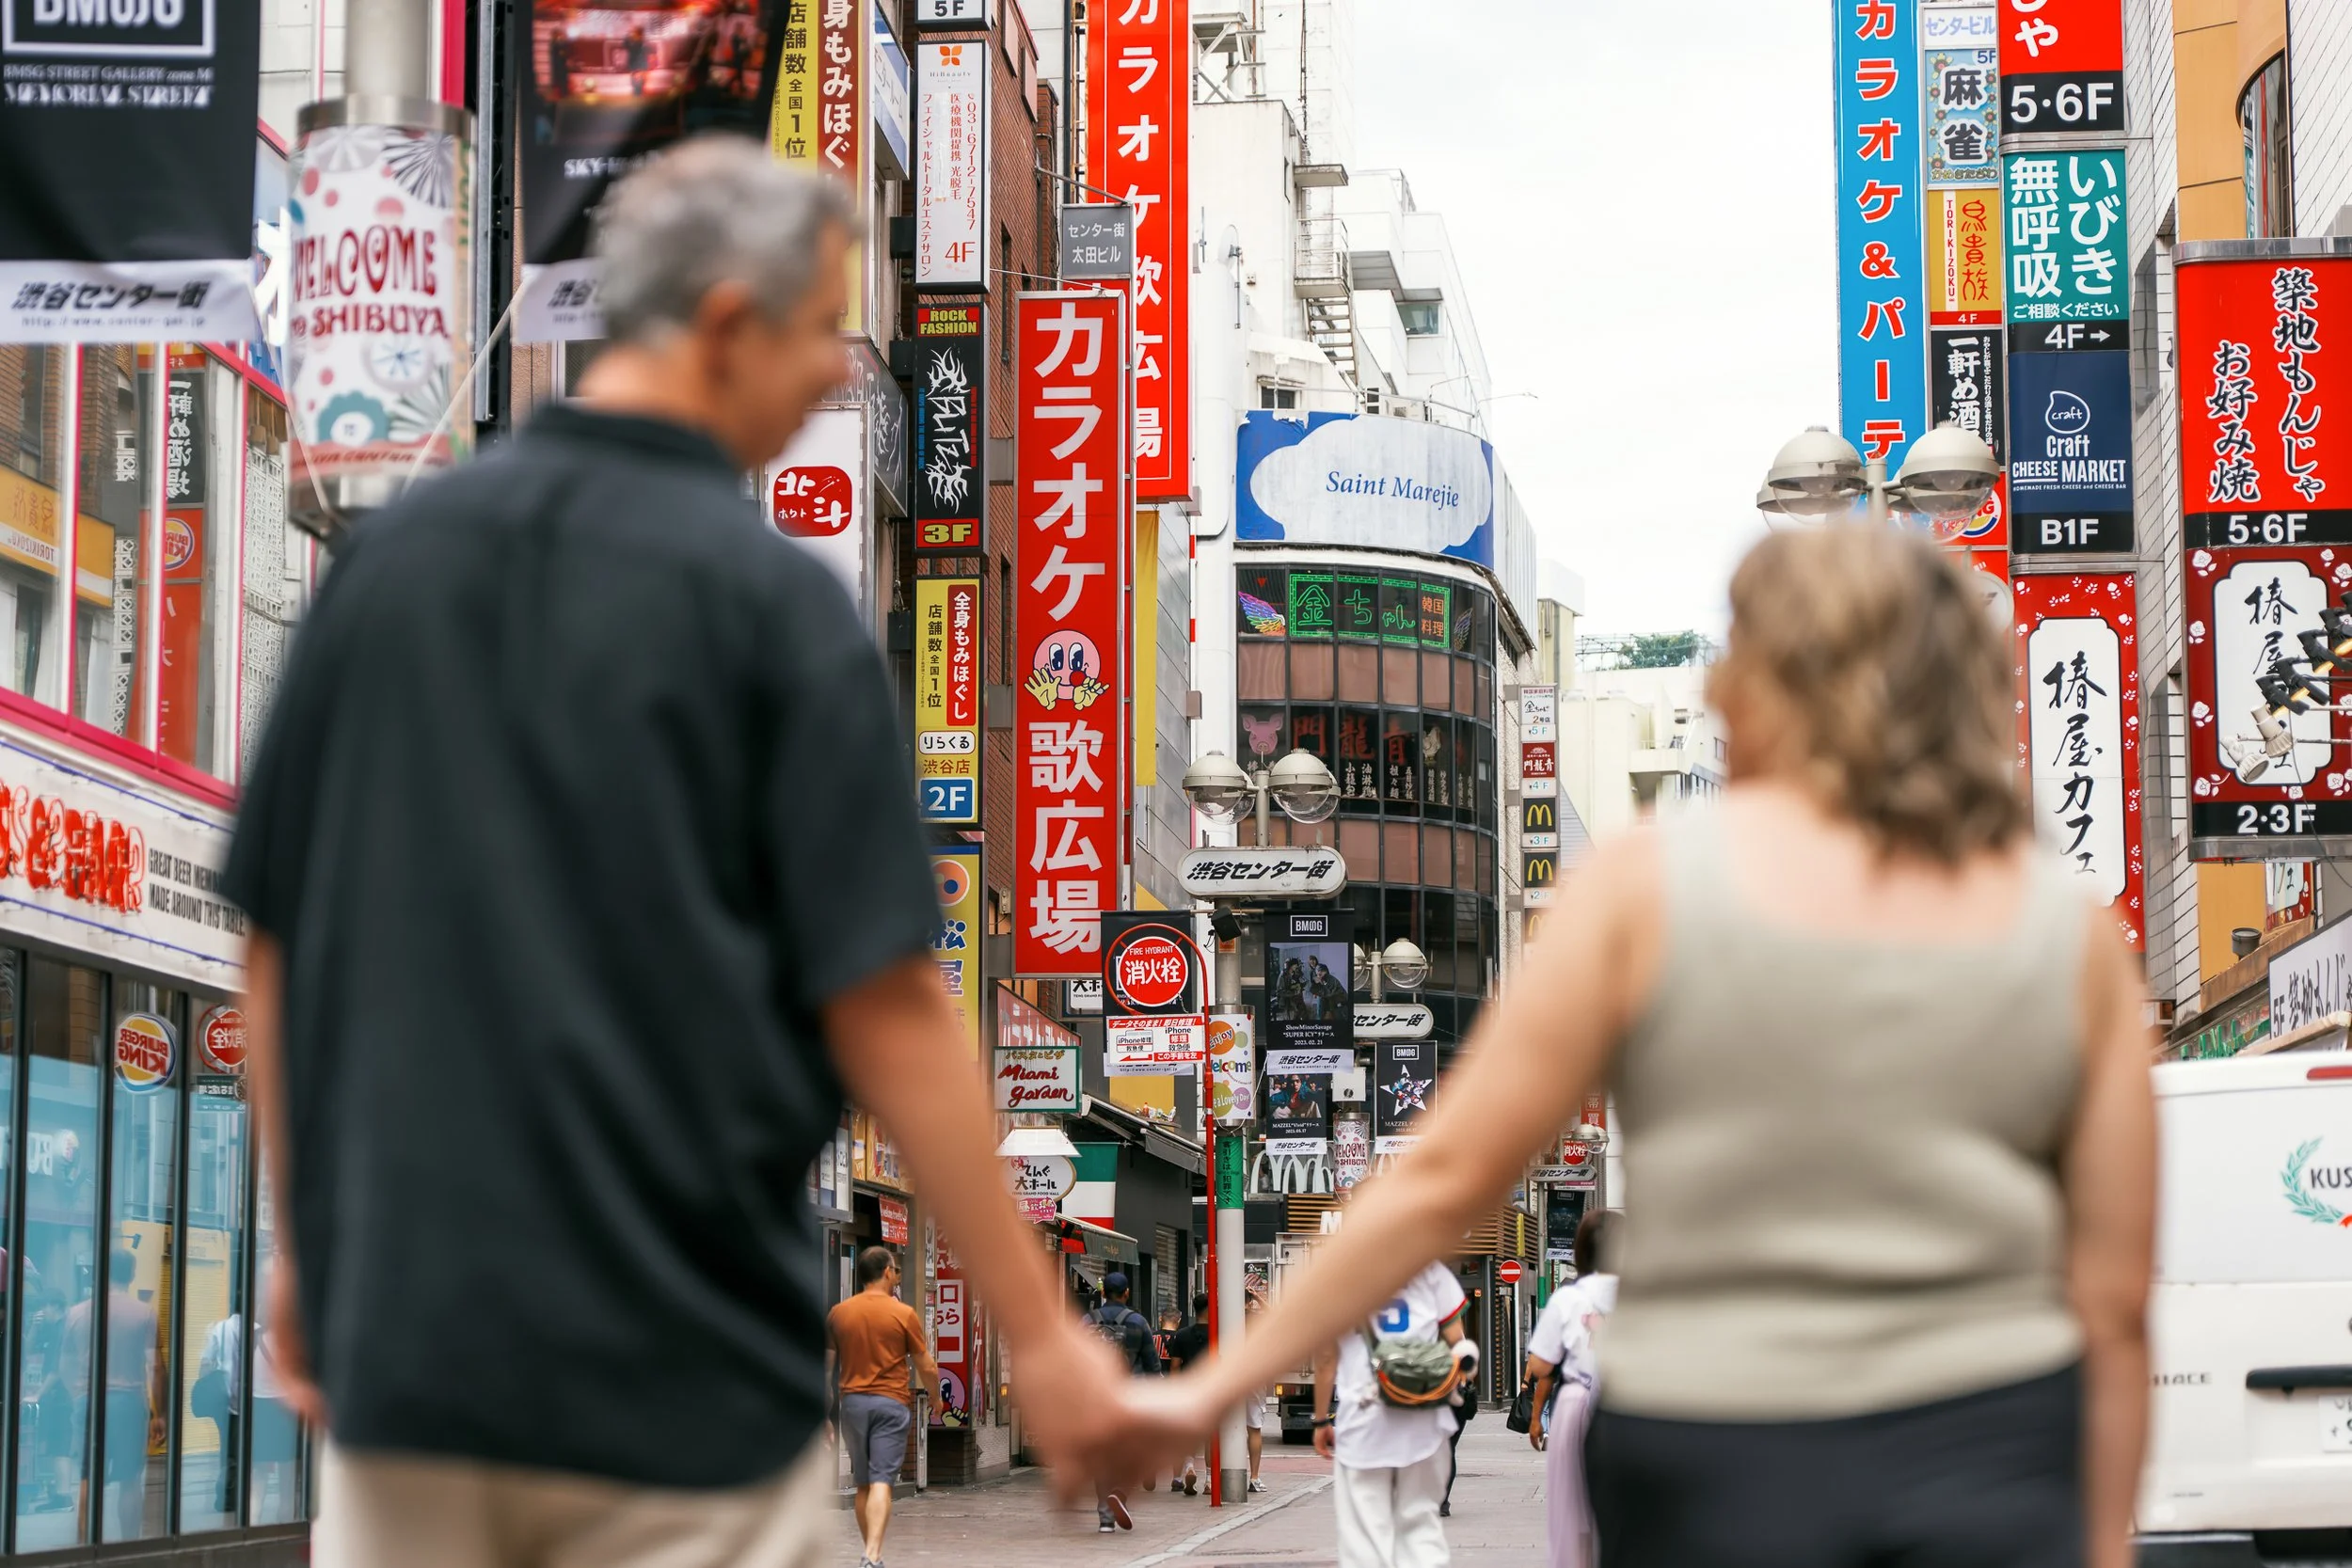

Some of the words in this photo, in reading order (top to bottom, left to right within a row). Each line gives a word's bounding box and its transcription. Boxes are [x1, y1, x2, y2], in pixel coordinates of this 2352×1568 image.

[934, 1, 964, 17] 5F
[1925, 16, 1995, 36] センタービル
[822, 0, 853, 179] 身もみほぐ
[1944, 69, 1983, 161] 麻雀
[1068, 222, 1125, 238] センター街
[2010, 157, 2062, 298] 無呼吸
[2069, 156, 2121, 295] いびき
[945, 242, 976, 263] 4F
[1073, 245, 1121, 263] 太田ビル
[1947, 200, 1955, 296] TORIKIZOKU
[1962, 199, 1989, 301] 鳥貴族
[291, 226, 437, 302] WELCOME
[11, 281, 211, 309] 渋谷センター街
[930, 309, 967, 322] ROCK
[1958, 314, 1978, 324] 4F
[2013, 303, 2120, 319] ご相談ください
[312, 305, 451, 340] SHIBUYA
[920, 322, 977, 335] FASHION
[2045, 324, 2086, 349] 4F
[2273, 269, 2324, 499] 築地もんじゃ
[2052, 407, 2083, 420] craft
[2208, 341, 2258, 501] お好み焼
[2046, 435, 2090, 458] Craft
[1031, 302, 1105, 622] カラオケ
[2012, 461, 2058, 478] CHEESE
[2061, 459, 2126, 483] MARKET
[1327, 471, 1386, 496] Saint
[1391, 477, 1458, 510] Marejie
[778, 507, 807, 519] ホクト
[924, 524, 971, 543] 3F
[2042, 518, 2099, 546] B1F
[1297, 585, 1415, 630] 金ちゃん
[1422, 596, 1444, 613] 韓国
[1422, 619, 1443, 637] 料理
[927, 604, 943, 708] 店舗数全国1位
[953, 591, 971, 720] 全身もみほぐし
[923, 736, 970, 749] りらくる
[923, 759, 971, 774] 渋谷店
[1524, 758, 1554, 771] 門龍青
[2042, 651, 2107, 875] 椿屋カフェ
[928, 786, 966, 811] 2F
[1029, 719, 1104, 955] 歌広場
[149, 847, 172, 879] GREAT
[173, 857, 192, 888] BEER
[1187, 860, 1335, 880] 渋谷センター街
[149, 882, 170, 914] MADE
[171, 890, 202, 924] AROUND
[203, 899, 221, 929] THIS
[1145, 945, 1174, 955] HYDRANT
[1124, 958, 1182, 986] 消火栓
[1352, 1014, 1426, 1027] センター街
[2273, 994, 2285, 1037] 5F
[1211, 1059, 1251, 1072] elcome
[1279, 1055, 1341, 1064] 渋谷センター街
[998, 1065, 1059, 1081] Miami
[1336, 1143, 1365, 1157] WELCOME
[1564, 1145, 1587, 1156] 消火栓
[1014, 1176, 1057, 1191] 大ホール
[1531, 1168, 1589, 1177] 渋谷センター街
